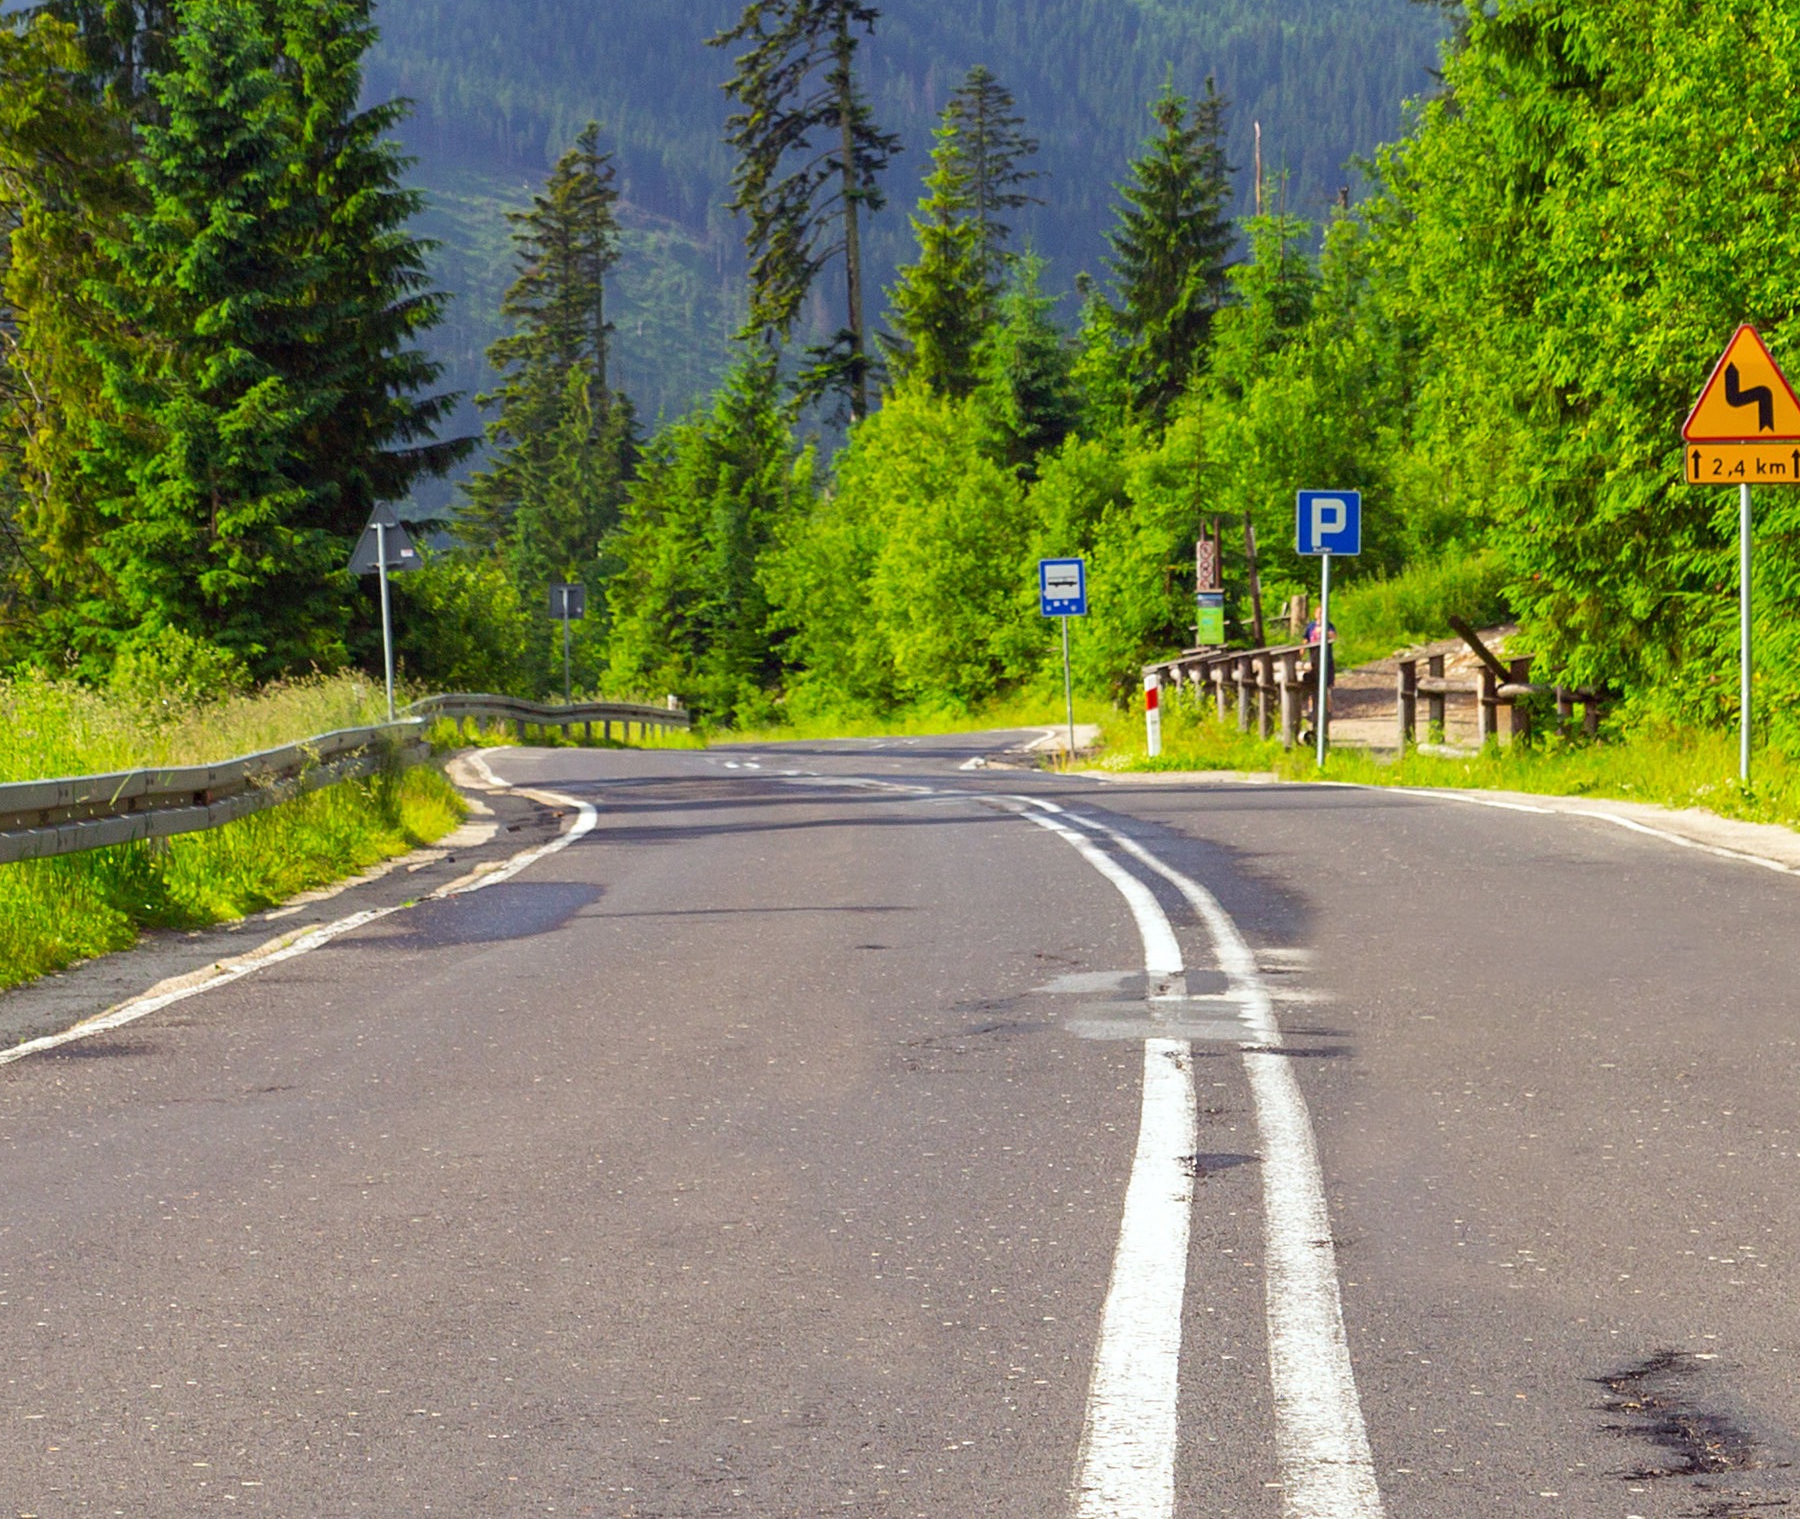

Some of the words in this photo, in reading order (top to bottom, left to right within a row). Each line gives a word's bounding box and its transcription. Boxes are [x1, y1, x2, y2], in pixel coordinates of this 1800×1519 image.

[1712, 457, 1745, 477] 2,4
[1756, 457, 1786, 475] km
[1311, 498, 1347, 547] P
